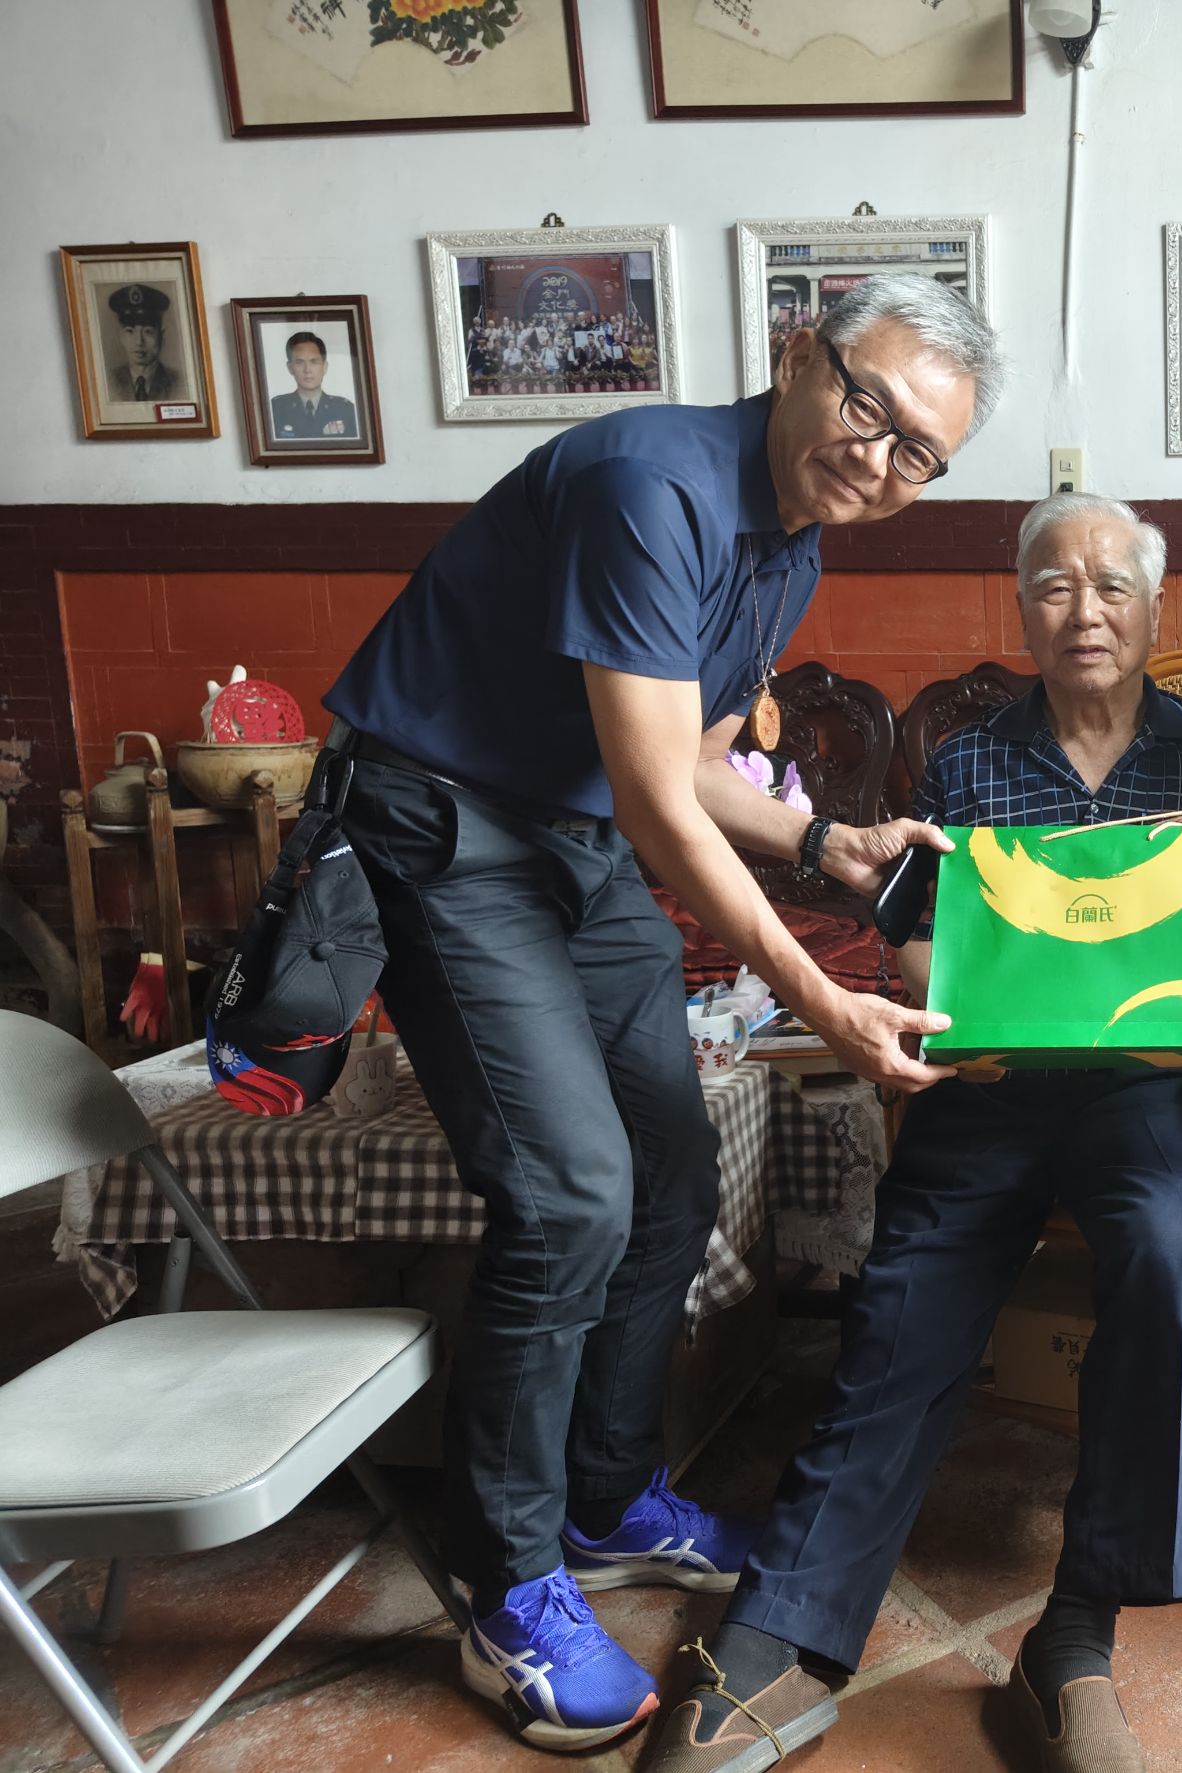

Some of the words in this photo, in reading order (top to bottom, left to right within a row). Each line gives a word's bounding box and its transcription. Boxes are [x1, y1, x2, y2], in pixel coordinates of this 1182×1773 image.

[542, 275, 568, 287] 2019
[1065, 906, 1115, 923] 白蘭氏
[223, 971, 247, 1007] ARB
